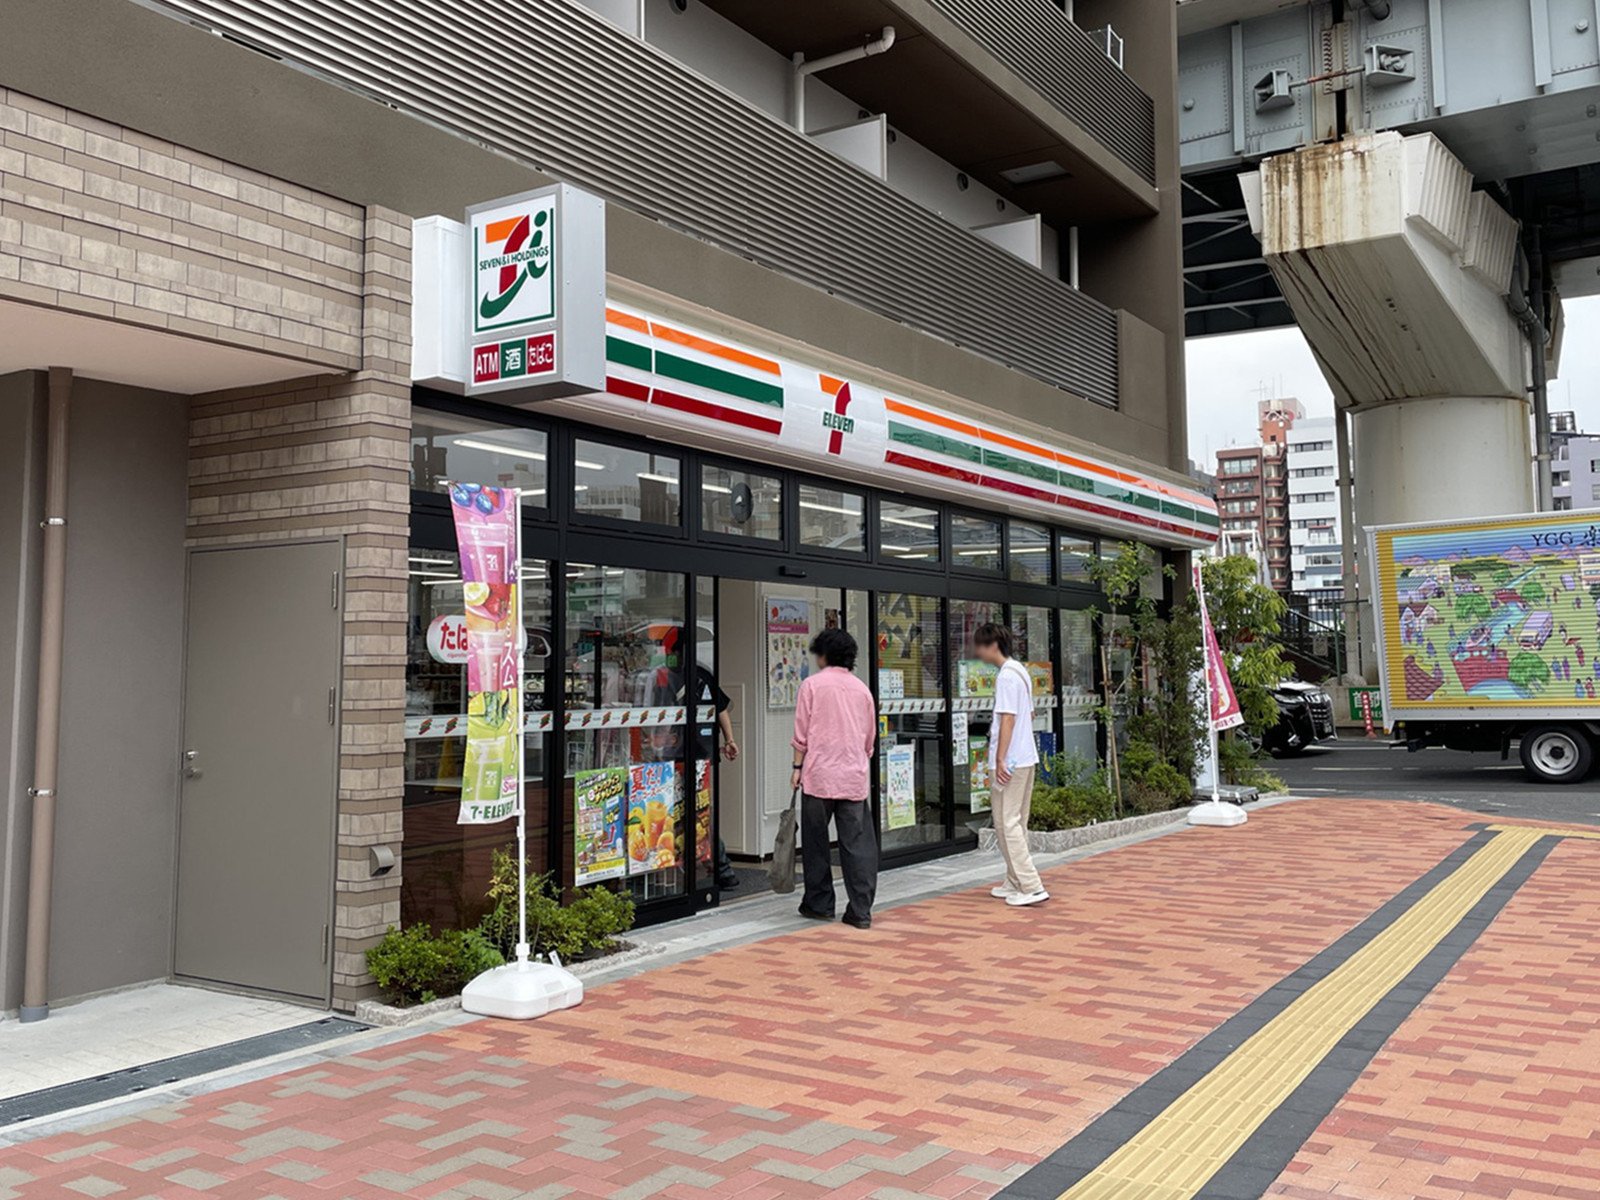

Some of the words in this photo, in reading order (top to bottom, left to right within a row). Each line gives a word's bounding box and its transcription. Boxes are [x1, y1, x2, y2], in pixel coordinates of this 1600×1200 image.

[511, 245, 549, 263] HOLDINGS
[475, 351, 499, 376] ATM
[504, 347, 522, 372] 酒
[528, 342, 554, 367] たばこ
[1531, 531, 1574, 547] YGG
